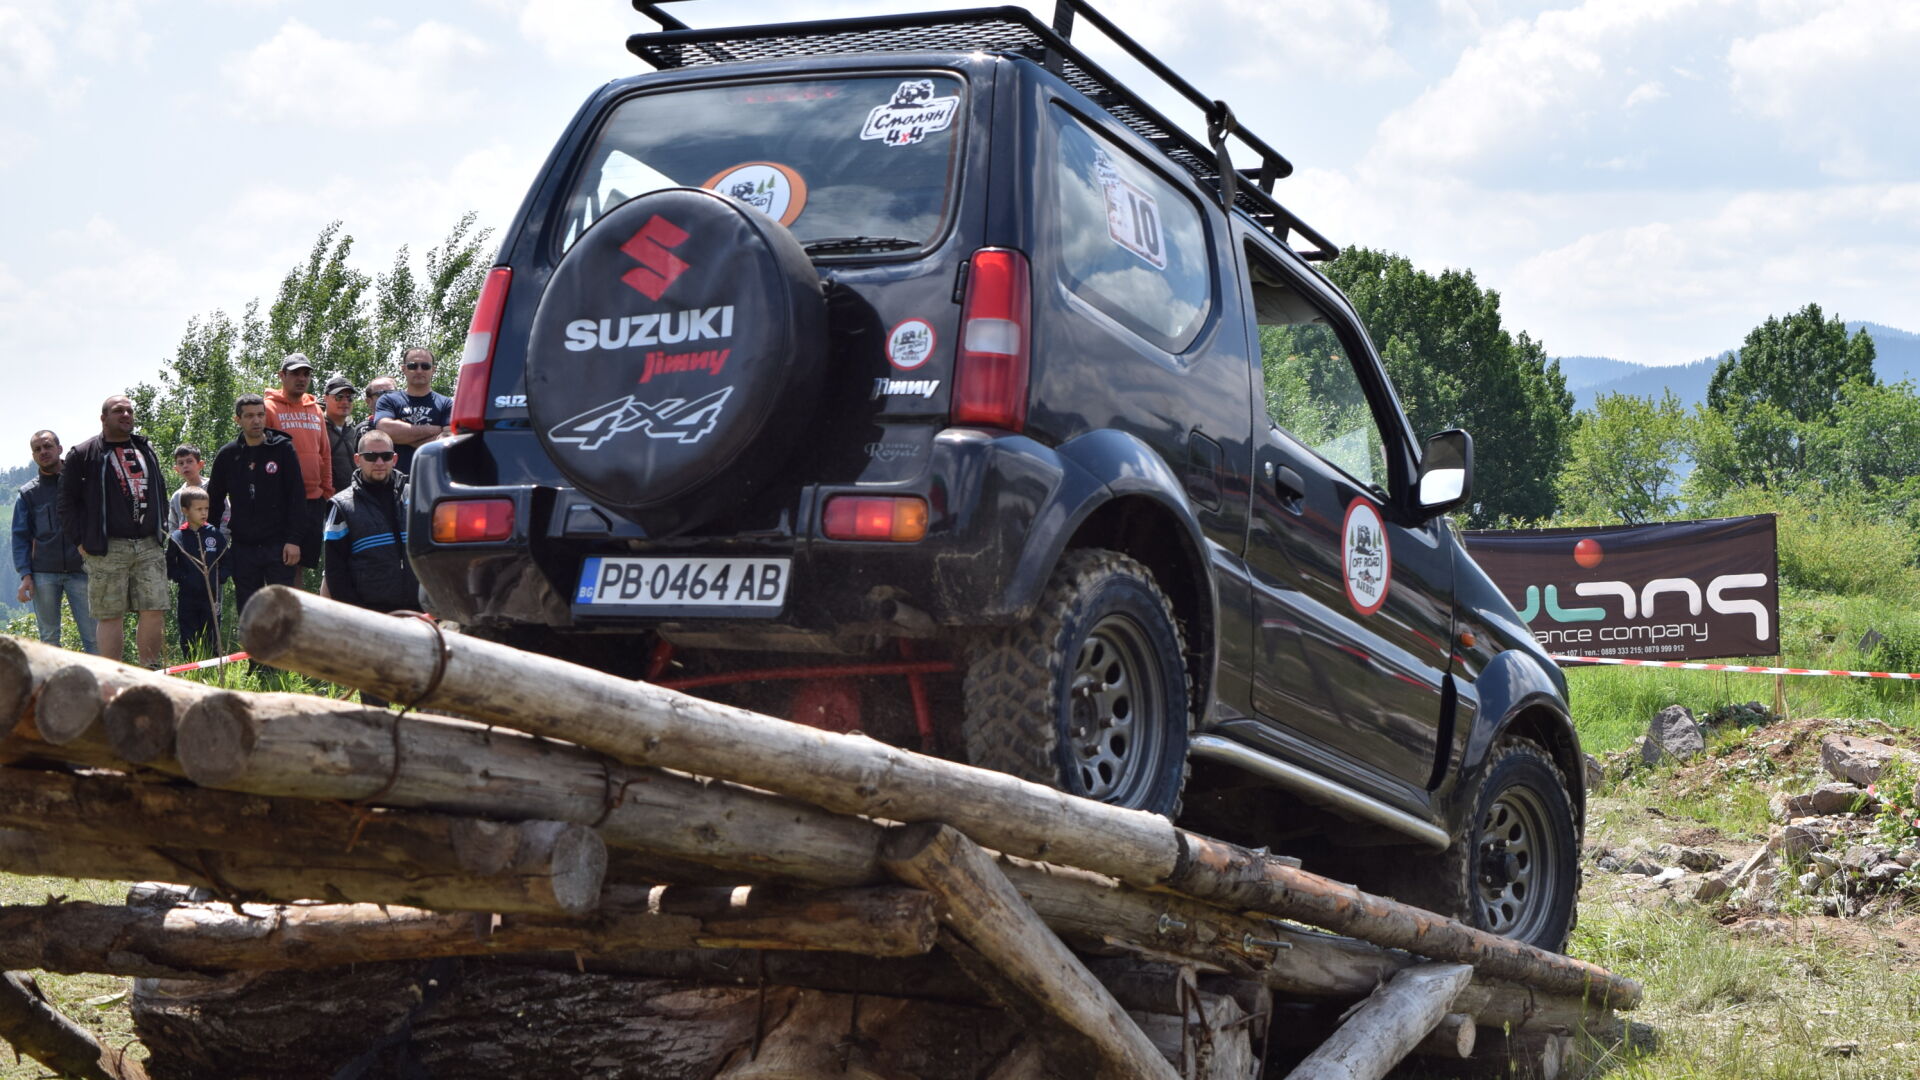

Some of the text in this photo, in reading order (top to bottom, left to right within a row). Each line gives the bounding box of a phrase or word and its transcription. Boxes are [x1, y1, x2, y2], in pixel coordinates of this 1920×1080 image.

[874, 109, 946, 130] Смолян
[886, 127, 923, 144] 4x4
[1127, 190, 1160, 256] 10
[564, 305, 735, 351] SUZUKI
[638, 349, 732, 384] Jimny
[870, 377, 940, 399] Jimny
[548, 385, 735, 450] 4x4
[1352, 556, 1380, 568] OFF ROAD
[579, 586, 593, 598] BG
[1600, 622, 1709, 645] company
[1566, 649, 1578, 657] 107
[1617, 647, 1629, 655] 333
[1673, 644, 1685, 652] 912
